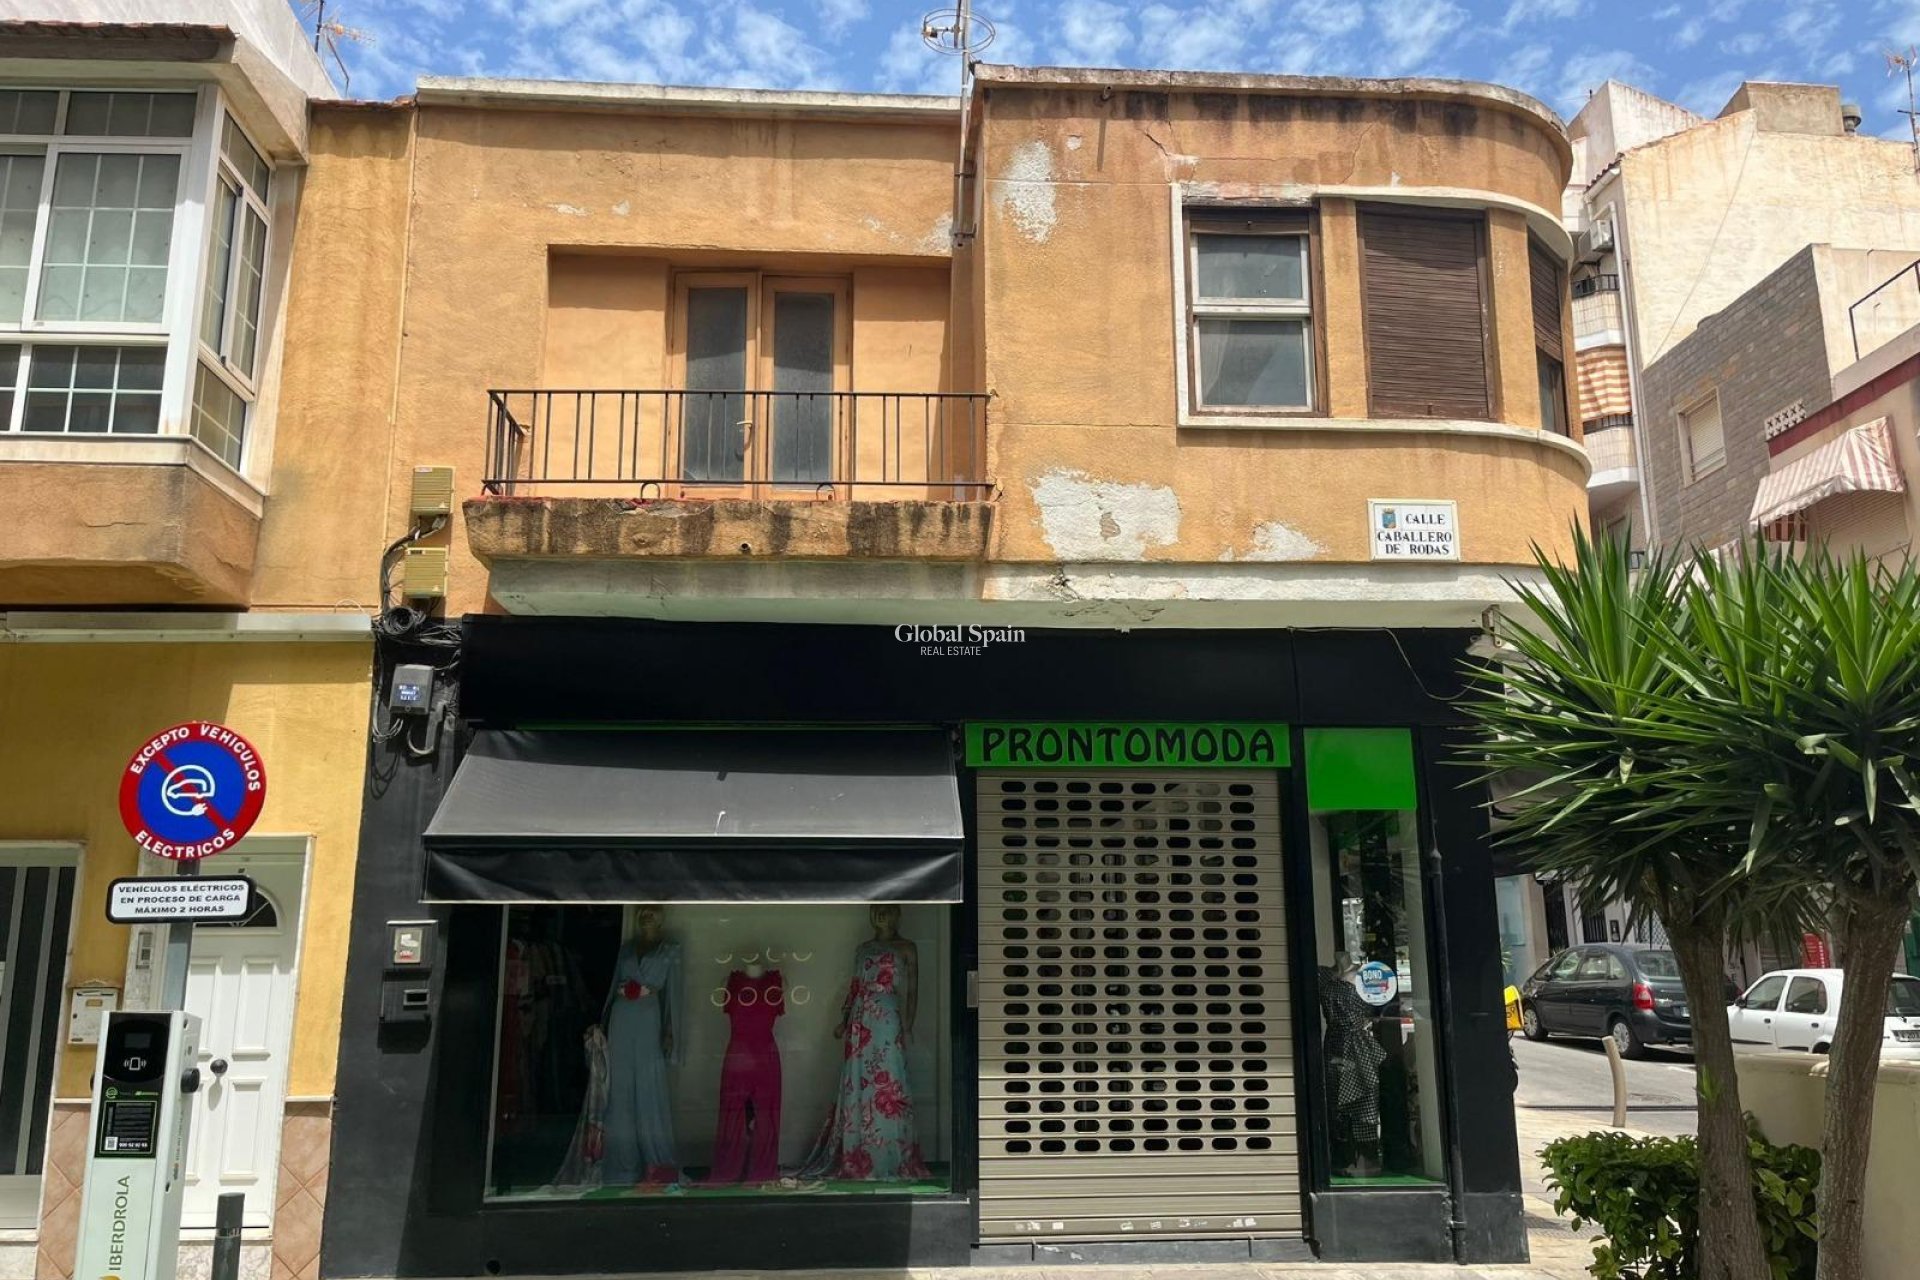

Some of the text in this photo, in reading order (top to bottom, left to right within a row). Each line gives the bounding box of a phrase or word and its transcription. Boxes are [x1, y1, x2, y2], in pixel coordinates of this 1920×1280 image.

[1405, 513, 1446, 525] CALLE
[1377, 531, 1452, 543] CABALLERO
[1385, 544, 1450, 555] DE RODAS
[982, 727, 1275, 763] PRONTOMODA
[130, 724, 262, 791] EXCEPTO VEHICULOS
[135, 828, 235, 858] ELECTRICOS
[118, 883, 245, 893] VEHÍCULOS ELÉCTRICOS
[120, 896, 134, 904] EN
[188, 895, 202, 903] DE
[205, 894, 241, 903] CARGA
[135, 906, 177, 914] MÁXIMO
[188, 905, 225, 913] HORAS
[108, 1175, 130, 1271] IBERDROLA
